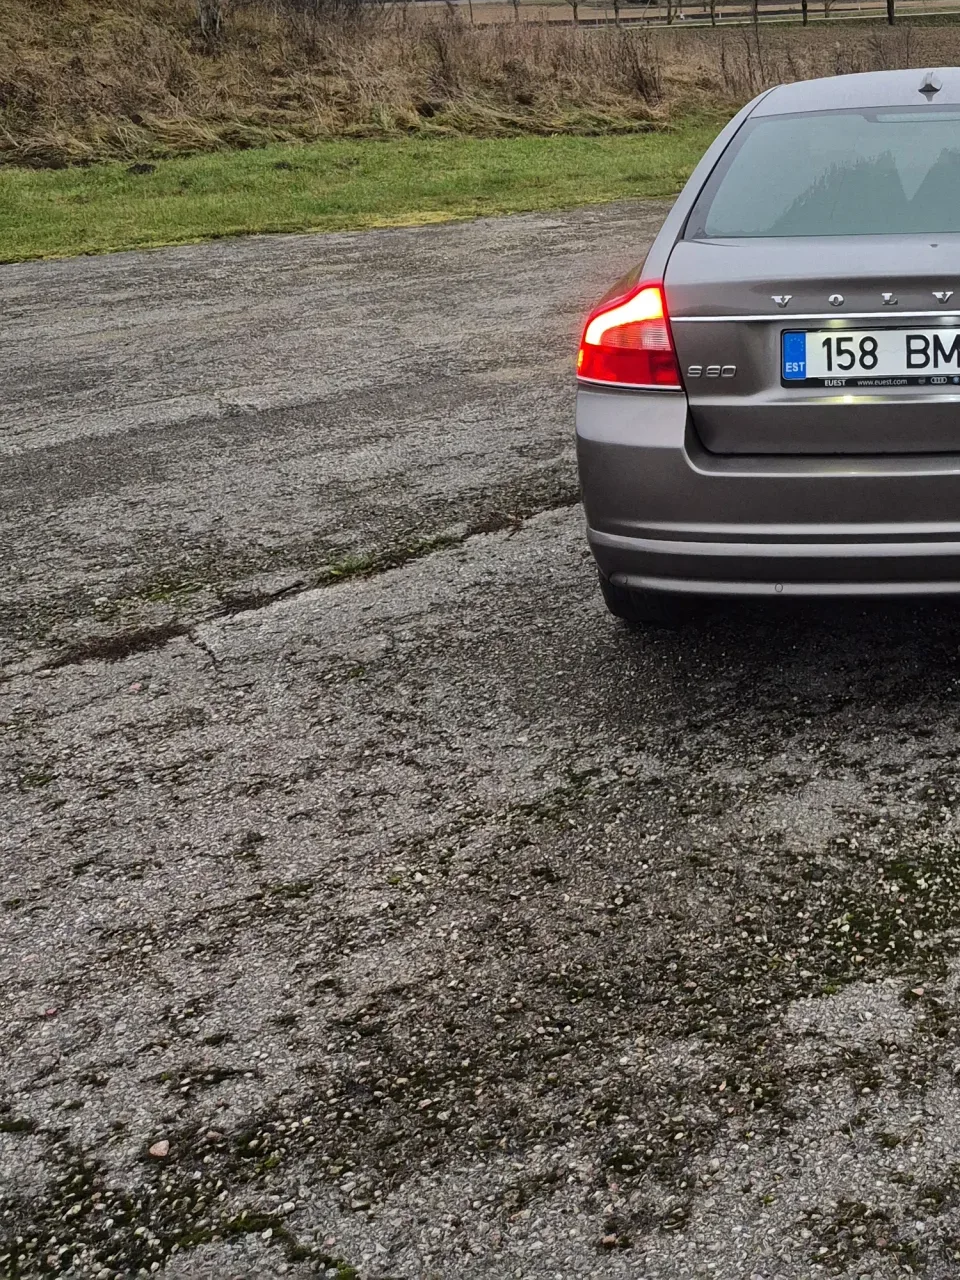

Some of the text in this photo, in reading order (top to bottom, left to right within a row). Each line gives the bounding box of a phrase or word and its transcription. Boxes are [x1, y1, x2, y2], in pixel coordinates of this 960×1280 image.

[822, 336, 878, 371] 158
[785, 361, 805, 373] EST
[824, 378, 908, 387] EUEST www.euest.com
